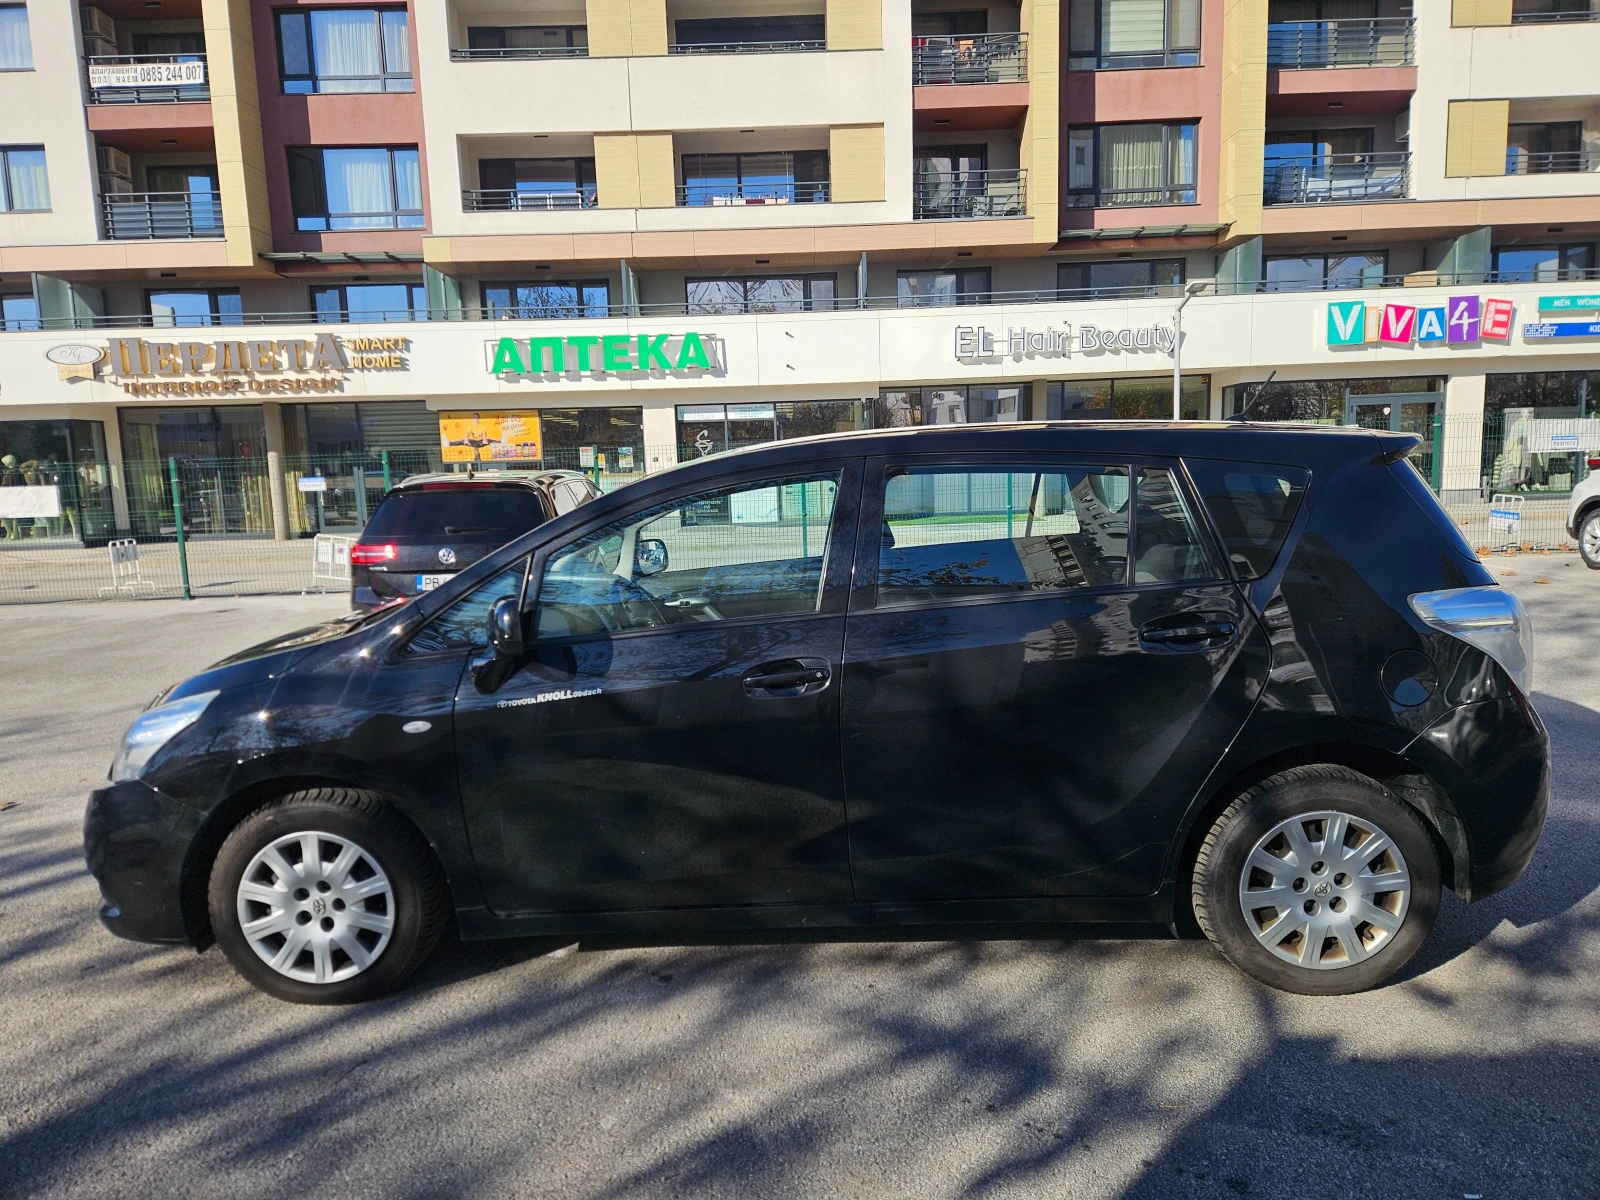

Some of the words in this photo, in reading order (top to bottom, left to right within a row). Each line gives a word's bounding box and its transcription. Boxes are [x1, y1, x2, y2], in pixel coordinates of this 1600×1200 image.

[91, 67, 138, 75] АПАРТАМЕНТИ
[140, 67, 162, 82] 0885
[166, 66, 183, 81] 244
[186, 65, 201, 80] 007
[92, 76, 107, 84] ПОД
[116, 75, 138, 83] НАЕМ
[1553, 299, 1571, 307] MEN
[344, 336, 406, 351] SMART
[955, 326, 994, 358] EL
[1007, 326, 1064, 354] Hair
[1079, 322, 1176, 352] Beauty
[491, 332, 711, 375] АПТЕКА
[349, 354, 402, 369] HOME
[124, 380, 241, 395] INTERIOR
[249, 377, 337, 391] DESIGN
[425, 577, 440, 589] PB
[508, 698, 537, 707] TOYOTA
[537, 690, 573, 703] KNOLL
